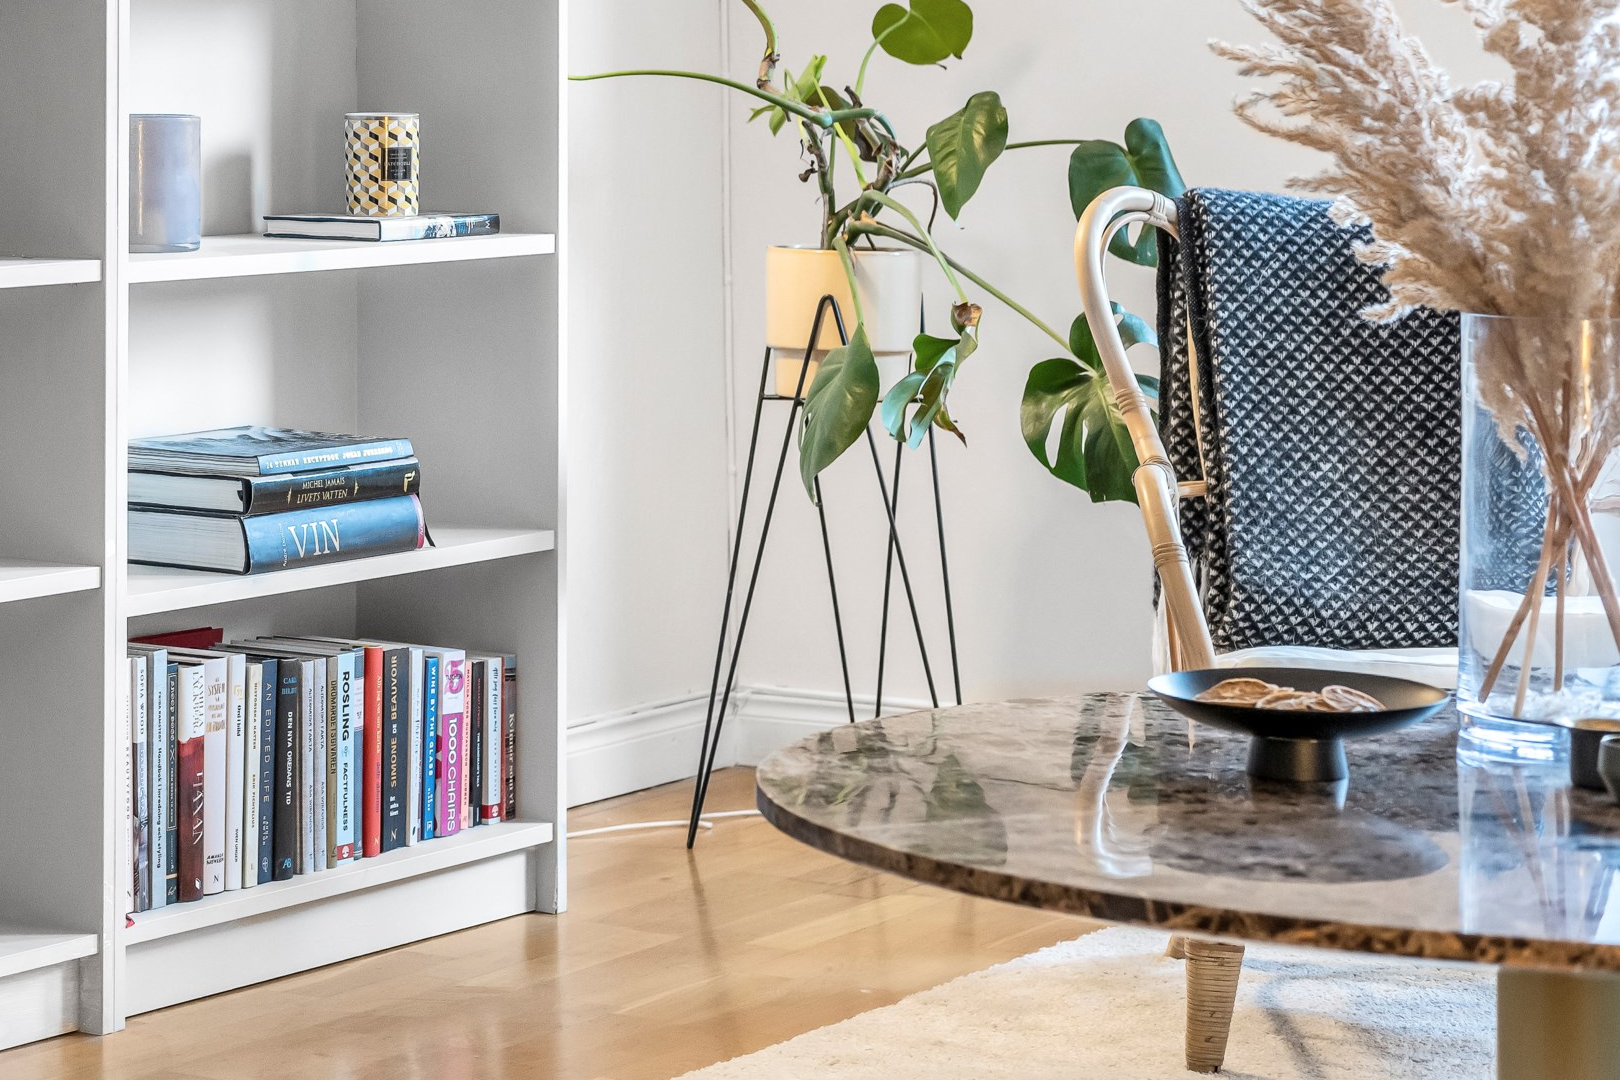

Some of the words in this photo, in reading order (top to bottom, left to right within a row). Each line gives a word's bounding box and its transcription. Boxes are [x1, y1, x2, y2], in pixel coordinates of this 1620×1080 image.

[297, 492, 321, 504] LIVETS
[322, 489, 348, 502] VATTEN
[302, 480, 323, 490] MICHEL
[325, 477, 345, 488] JAMAIS
[288, 518, 340, 558] VIN
[266, 682, 272, 701] AN
[390, 655, 398, 720] BEAUVOIR
[342, 671, 350, 741] ROSLING
[430, 698, 435, 712] BY
[448, 717, 458, 764] 1000
[447, 766, 457, 832] CHAIRS
[509, 793, 515, 804] vi
